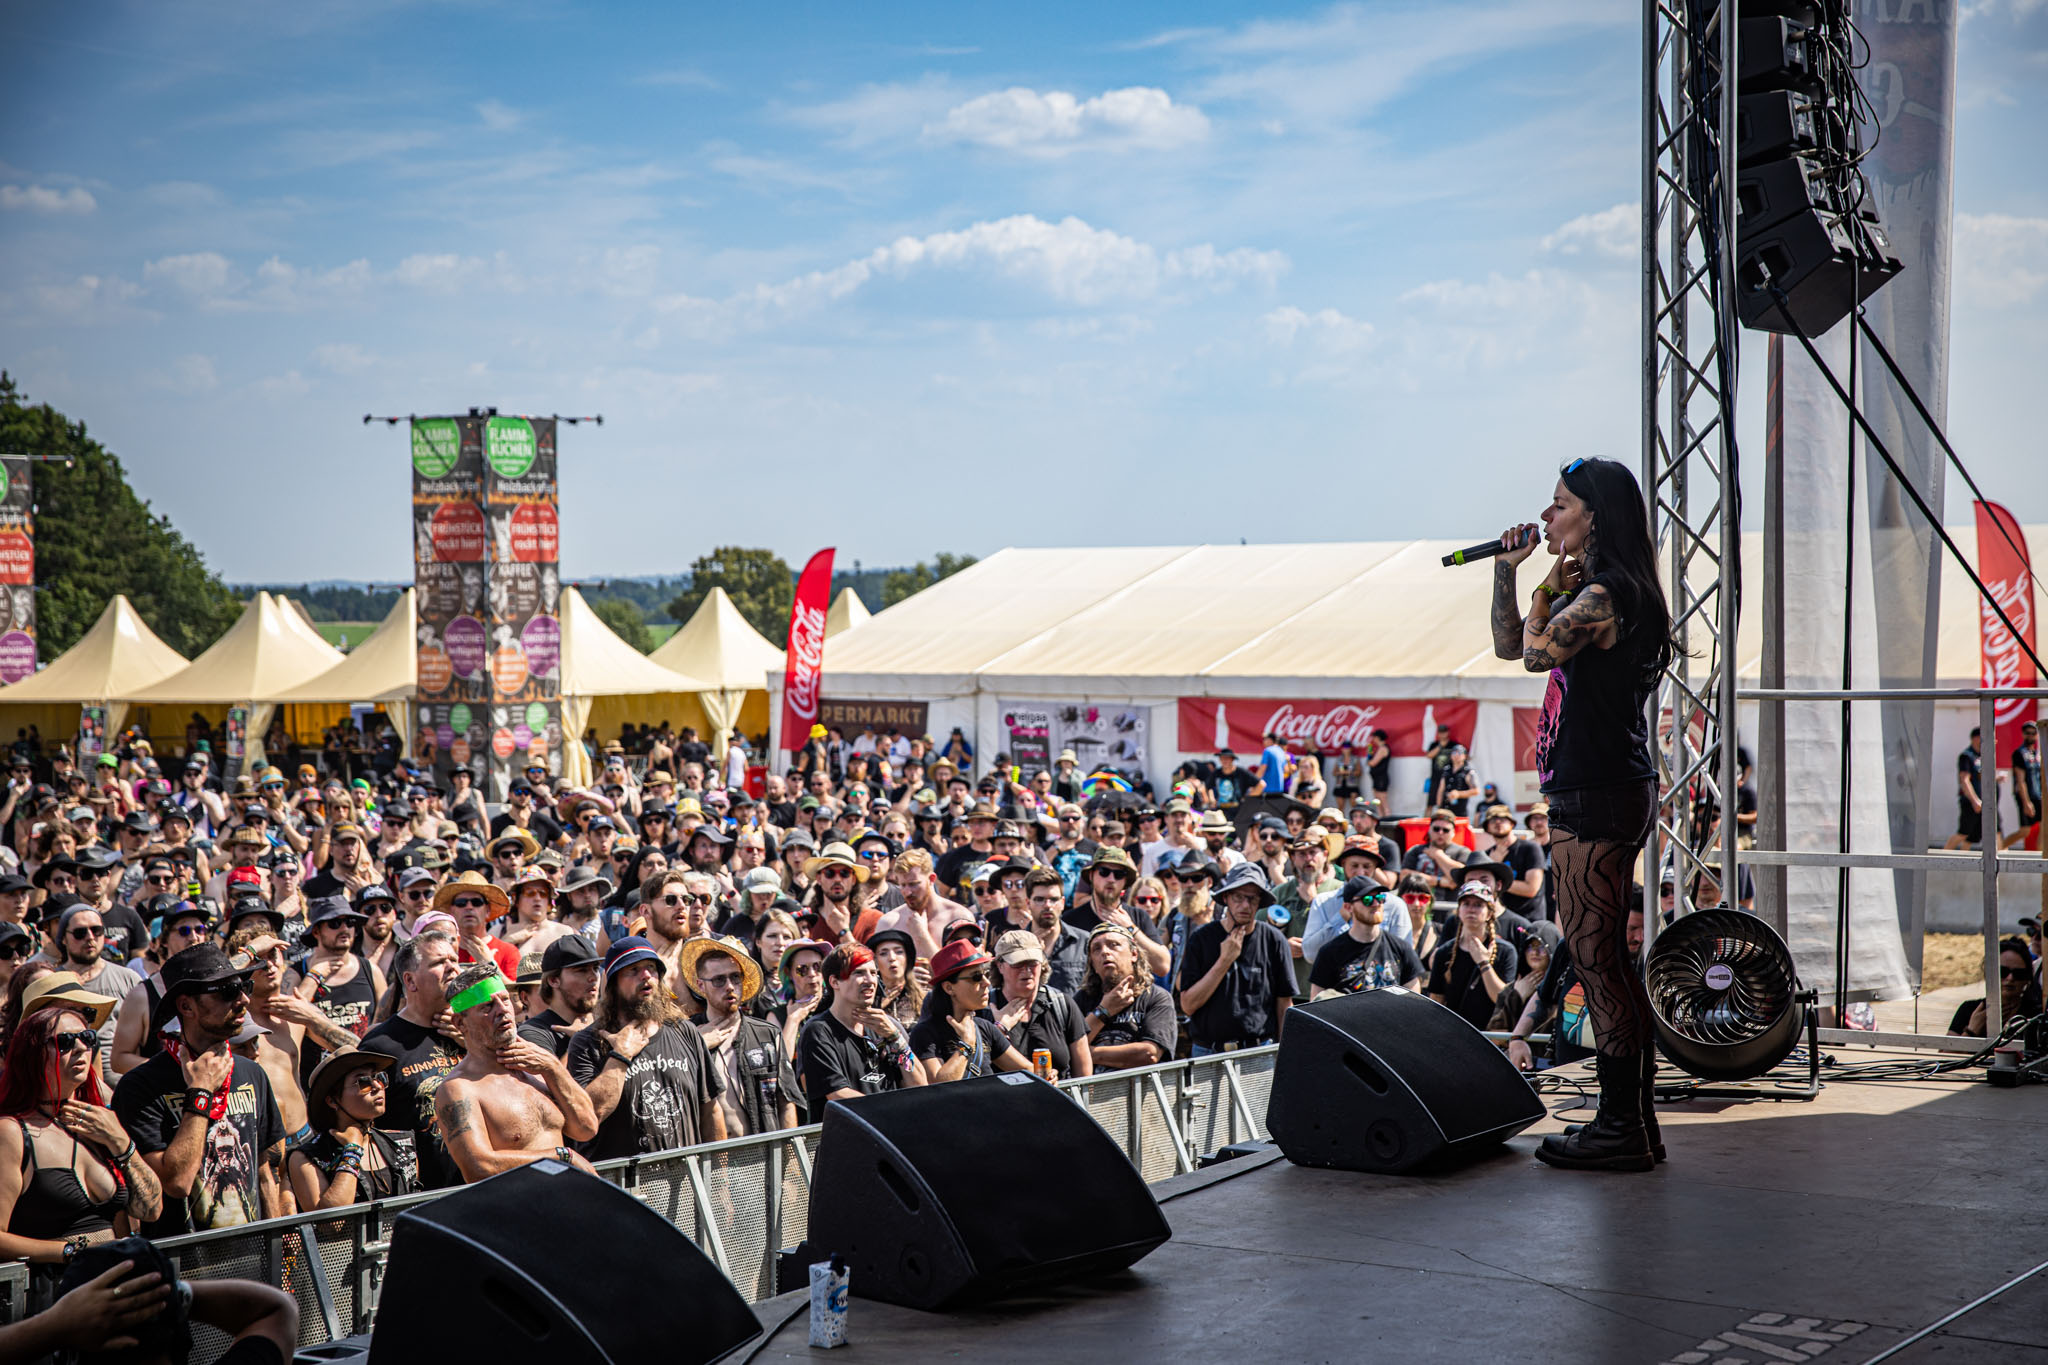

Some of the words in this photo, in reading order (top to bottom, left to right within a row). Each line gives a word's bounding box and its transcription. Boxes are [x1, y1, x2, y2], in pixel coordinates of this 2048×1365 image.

[786, 598, 825, 719] Coca-Cola
[1262, 704, 1381, 748] Coca-Cola
[402, 1057, 450, 1077] SUMMER
